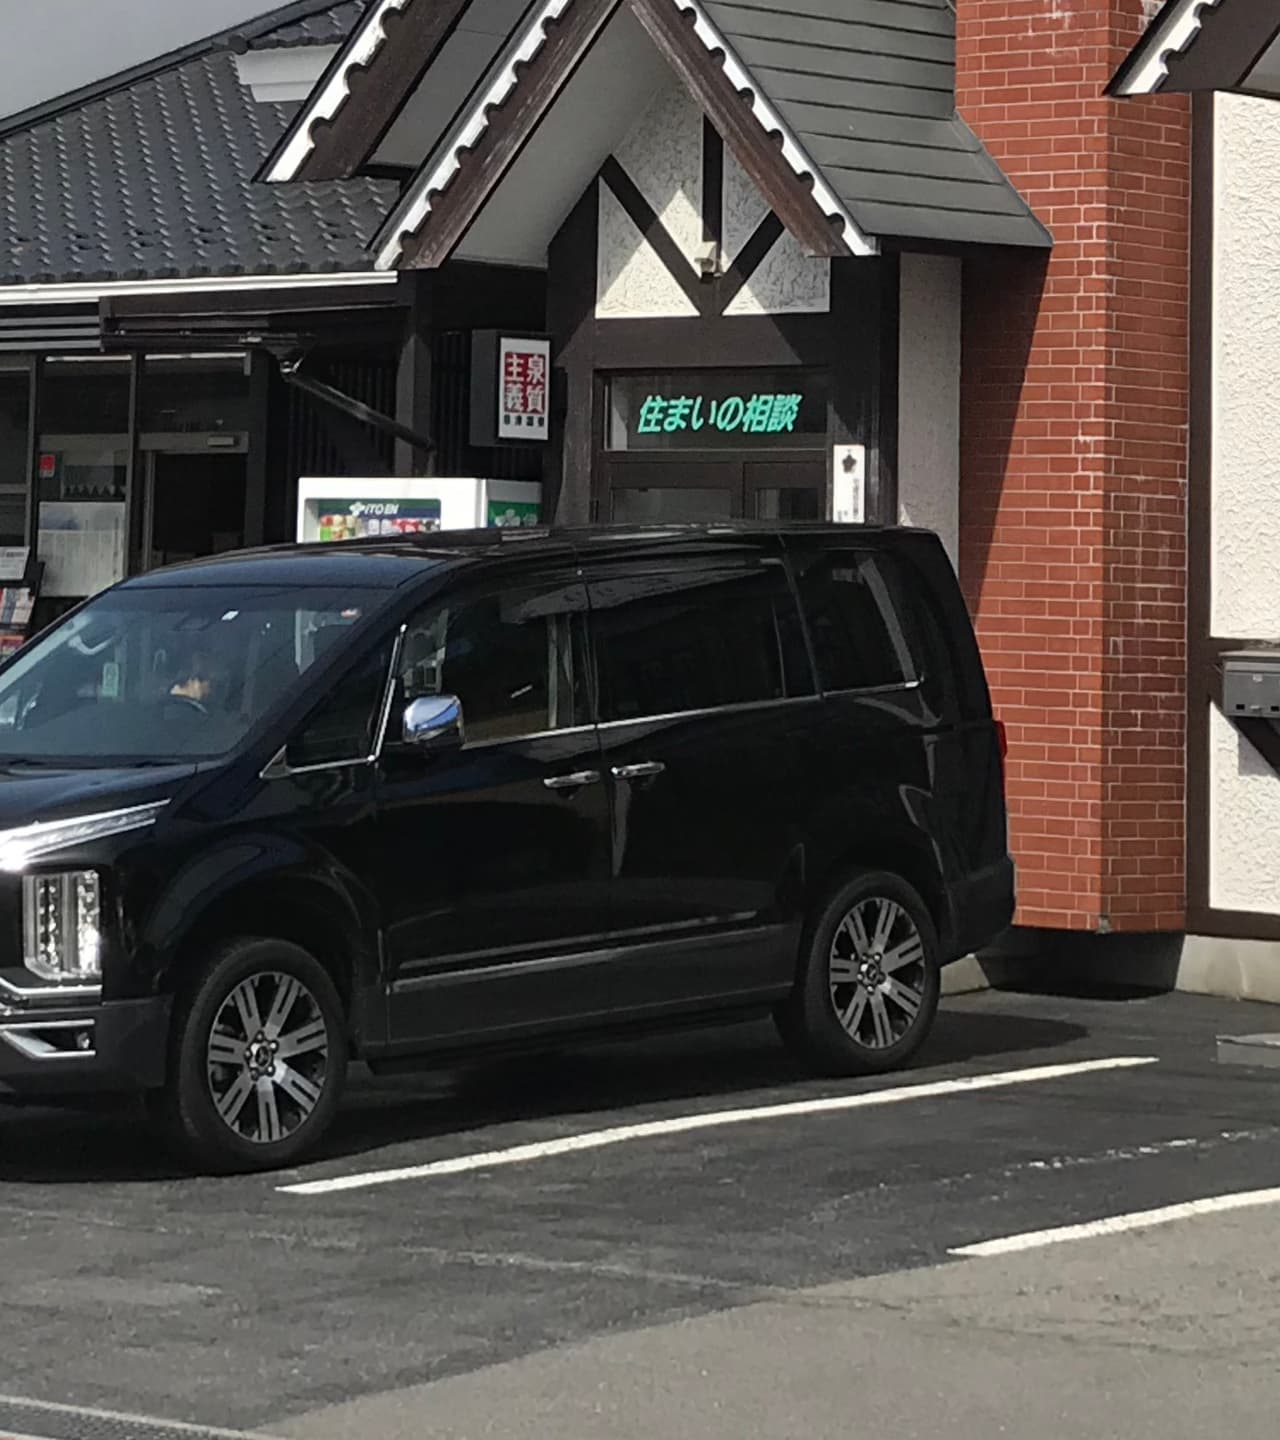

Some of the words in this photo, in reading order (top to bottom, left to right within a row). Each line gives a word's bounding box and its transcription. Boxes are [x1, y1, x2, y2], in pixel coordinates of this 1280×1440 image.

[637, 394, 803, 433] 住まいの相談
